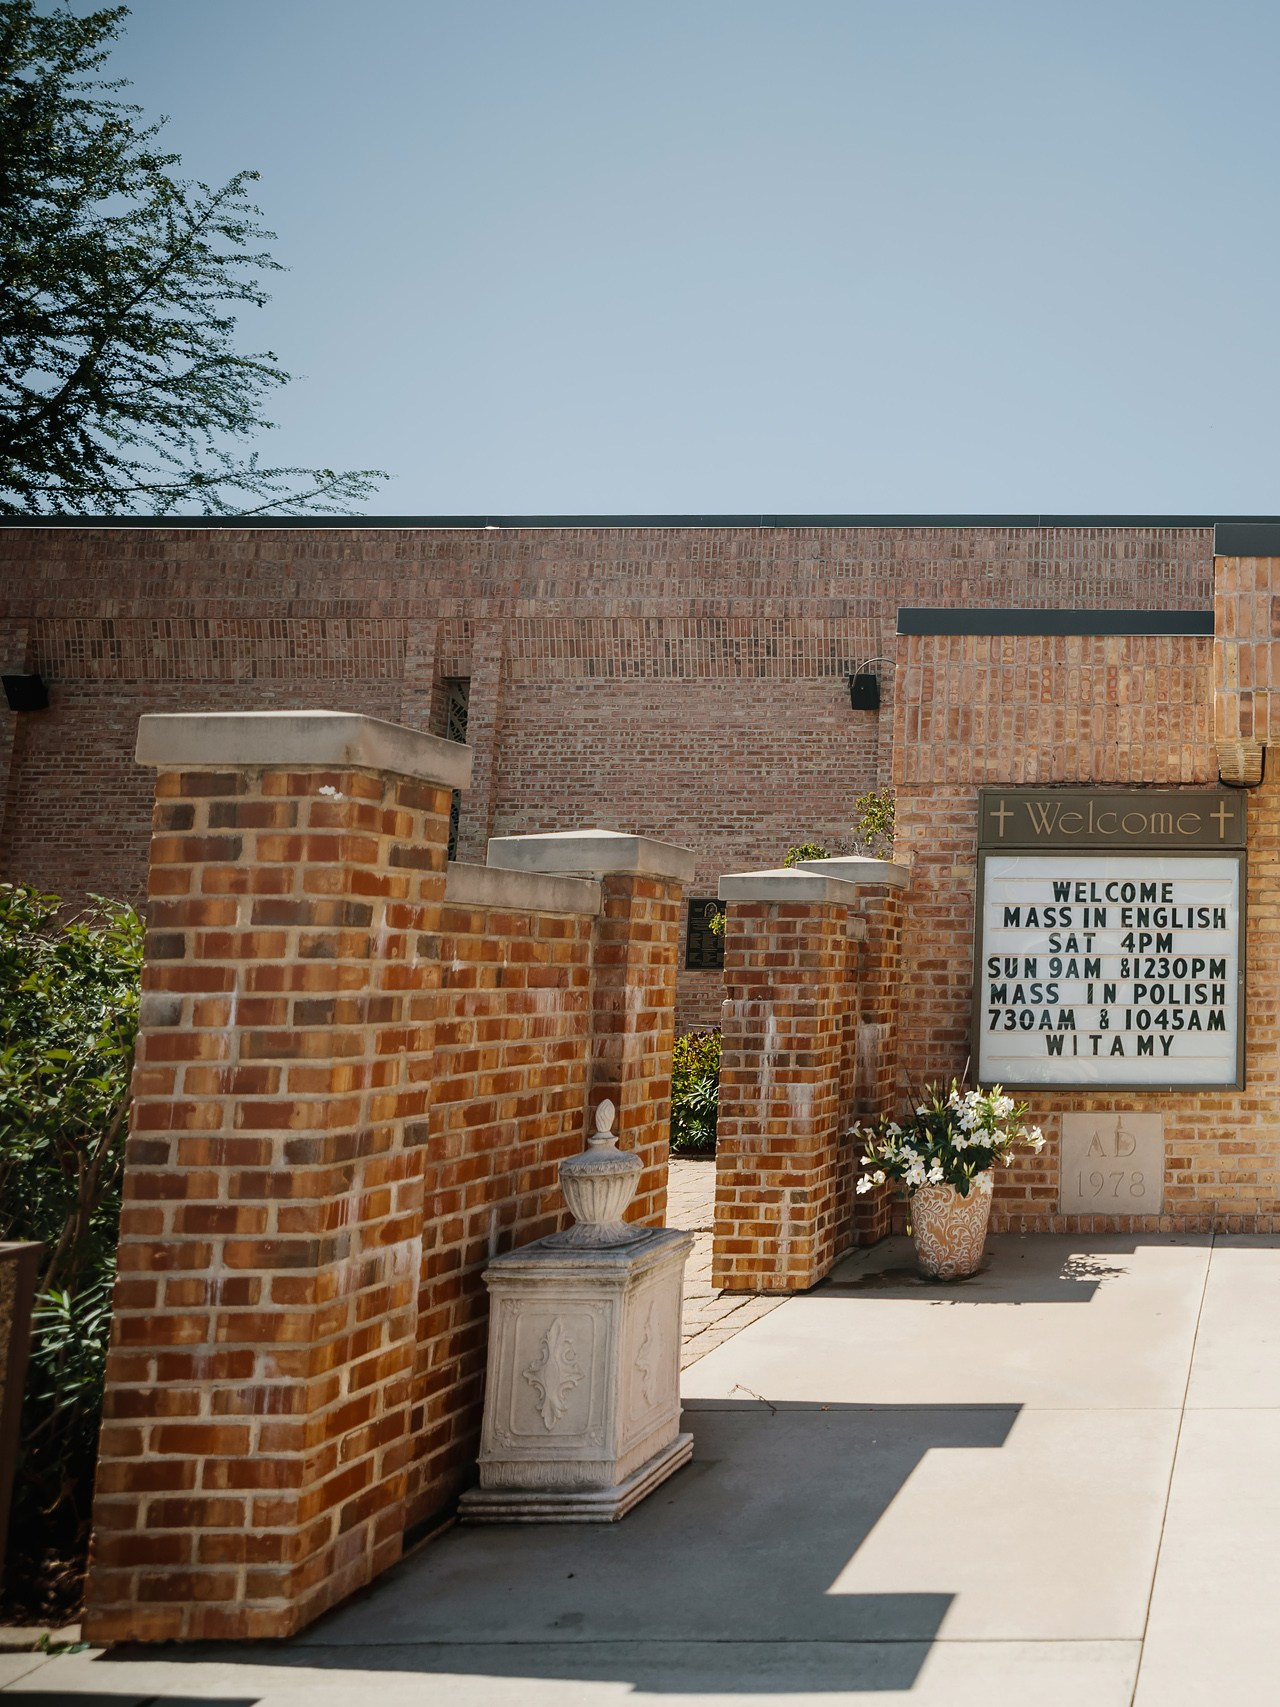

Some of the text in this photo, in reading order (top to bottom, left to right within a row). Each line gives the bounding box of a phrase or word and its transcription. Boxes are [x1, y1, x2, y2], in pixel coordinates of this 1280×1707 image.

[1023, 800, 1202, 836] Welcome
[1053, 881, 1174, 904] WELCOME
[1004, 907, 1226, 928] MASS IN ENGLISH
[1049, 932, 1173, 954] SAT 4PM
[987, 957, 1037, 979] SUN
[1050, 957, 1101, 979] 9AM
[990, 983, 1225, 1005] MASS IN POLISH
[988, 1009, 1226, 1031] 730AM & 1045AM
[1046, 1034, 1174, 1056] WITAMY
[1077, 1170, 1146, 1198] 1978
